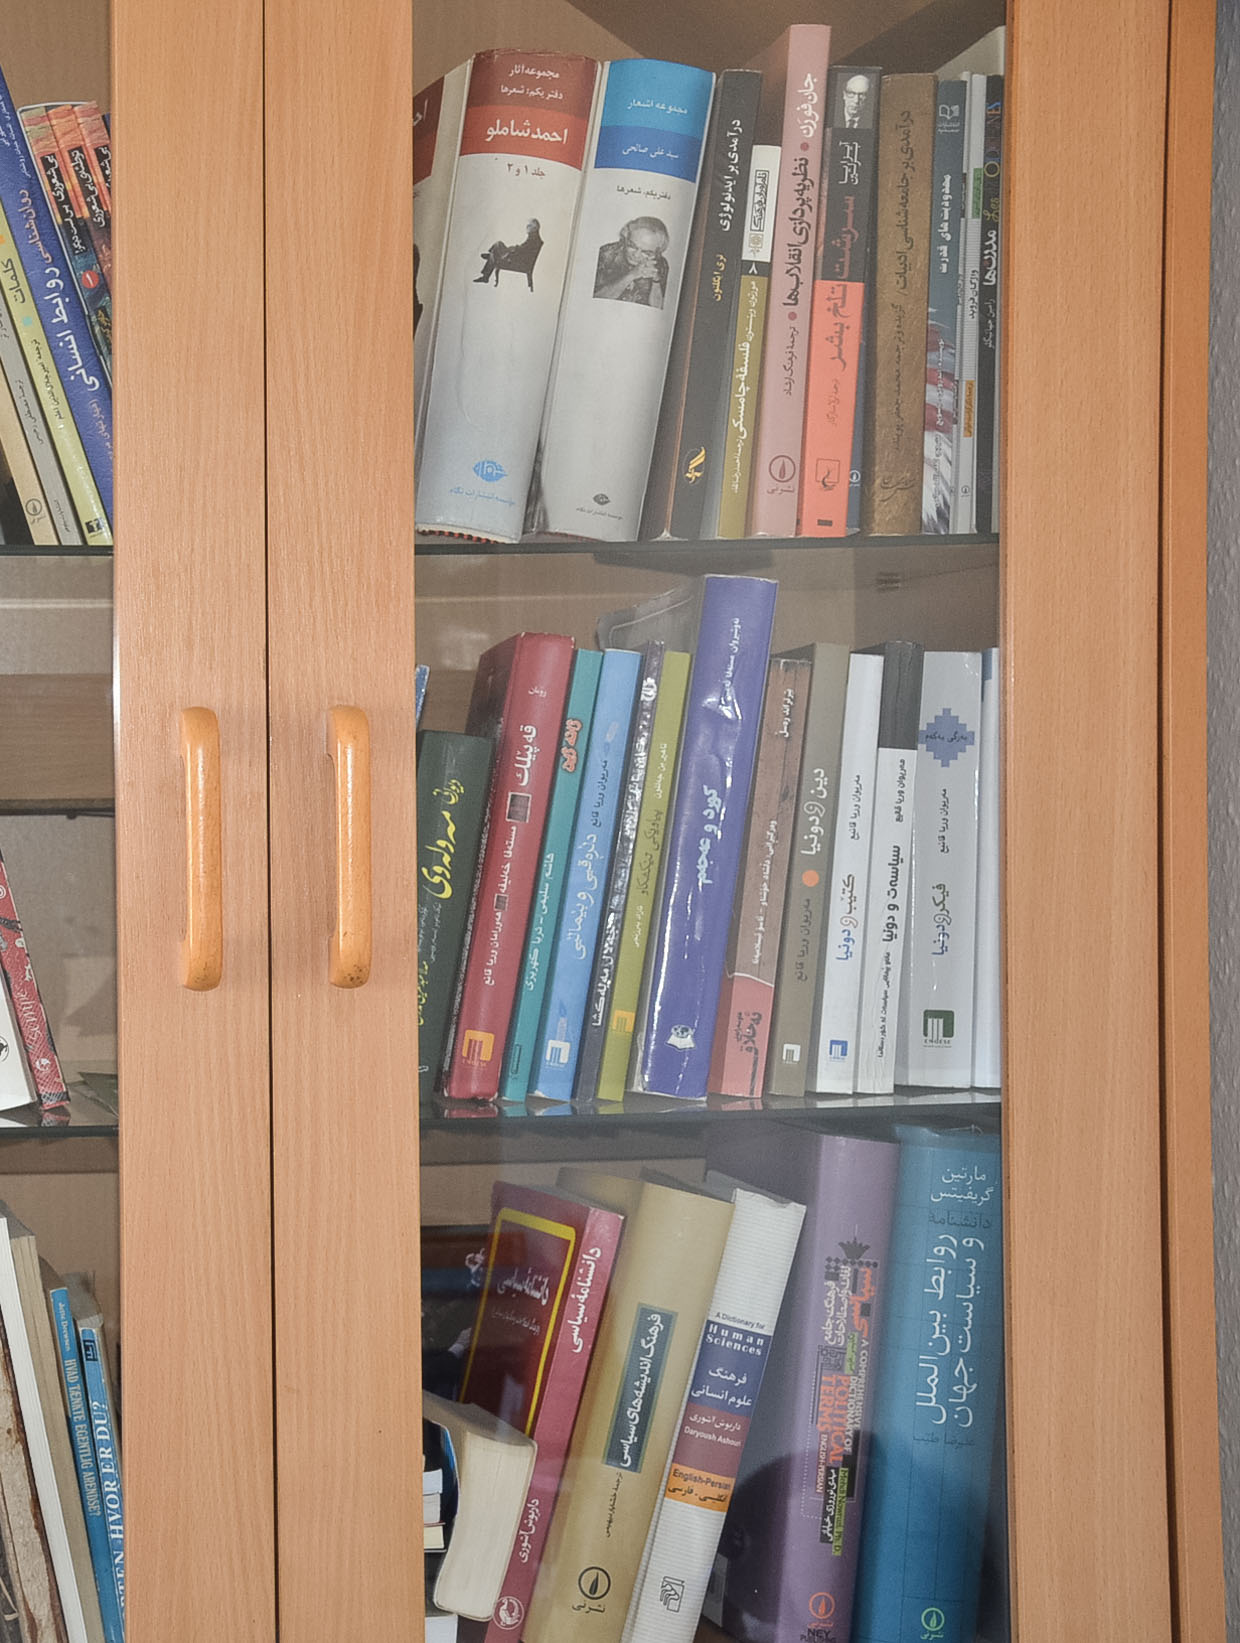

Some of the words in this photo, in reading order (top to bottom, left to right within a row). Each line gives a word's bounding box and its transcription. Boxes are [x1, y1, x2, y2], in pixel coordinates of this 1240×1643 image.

[627, 98, 656, 110] اشعار
[657, 102, 688, 115] مجموعه
[485, 119, 535, 142] شاملو
[534, 126, 568, 145] احمد
[727, 119, 743, 164] درآمدی
[728, 164, 739, 176] بر
[718, 175, 736, 232] ایدئولوژی
[834, 195, 859, 280] سرشت
[716, 253, 727, 271] تری
[937, 243, 949, 275] قدرت
[0, 258, 26, 304] کلمات
[44, 267, 70, 324] روابط
[712, 271, 726, 302] ایگلتون
[969, 269, 980, 296] واژگان
[826, 283, 851, 319] تلخ
[968, 296, 978, 319] فروید
[984, 299, 995, 317] رامین
[826, 322, 850, 372] بشر
[983, 320, 994, 349] جهانبگلو
[56, 330, 100, 391] انسانی
[810, 768, 828, 799] دین
[703, 784, 723, 820] کورد
[804, 801, 825, 817] و
[704, 823, 718, 838] و
[801, 816, 824, 856] دونیا
[840, 873, 855, 914] کتێب
[931, 883, 947, 914] فیکر
[840, 915, 858, 928] و
[934, 914, 952, 926] و
[836, 928, 856, 961] دونیا
[931, 925, 950, 956] دونیا
[941, 1166, 986, 1185] مارتین
[930, 1186, 994, 1206] گریفیتس
[961, 1236, 984, 1251] و
[924, 1234, 958, 1300] روابط
[956, 1257, 981, 1353] سیاست
[641, 1312, 665, 1358] فرهنگ
[709, 1323, 765, 1347] Human
[721, 1314, 754, 1329] Dictionary
[755, 1321, 766, 1331] for
[928, 1309, 950, 1356] بین
[705, 1334, 763, 1356] Sciences
[64, 1358, 79, 1383] HVAD
[708, 1367, 748, 1386] فرهنگ
[691, 1384, 729, 1401] انسانی
[728, 1393, 753, 1409] علوم
[817, 1375, 835, 1432] TERMS
[916, 1355, 947, 1424] الملل
[948, 1356, 977, 1428] جهان
[92, 1401, 111, 1441] DU?
[830, 1375, 850, 1463] POLITICAL
[846, 1376, 858, 1437] DICTIONARY
[684, 1426, 717, 1442] Daryoush
[715, 1417, 741, 1432] داریوش
[74, 1424, 93, 1469] EGENTLIG
[620, 1419, 638, 1468] سیاسی
[844, 1438, 853, 1453] OF
[99, 1446, 115, 1475] ER
[817, 1434, 828, 1493] ENGLISH-PERSIAN
[82, 1471, 102, 1517] ARENDSE?
[667, 1485, 695, 1498] فارسی
[104, 1479, 124, 1539] HVOR
[523, 1498, 540, 1534] داریوش
[571, 1602, 586, 1612] نی
[586, 1604, 606, 1614] نشر
[807, 1628, 830, 1637] NEY
